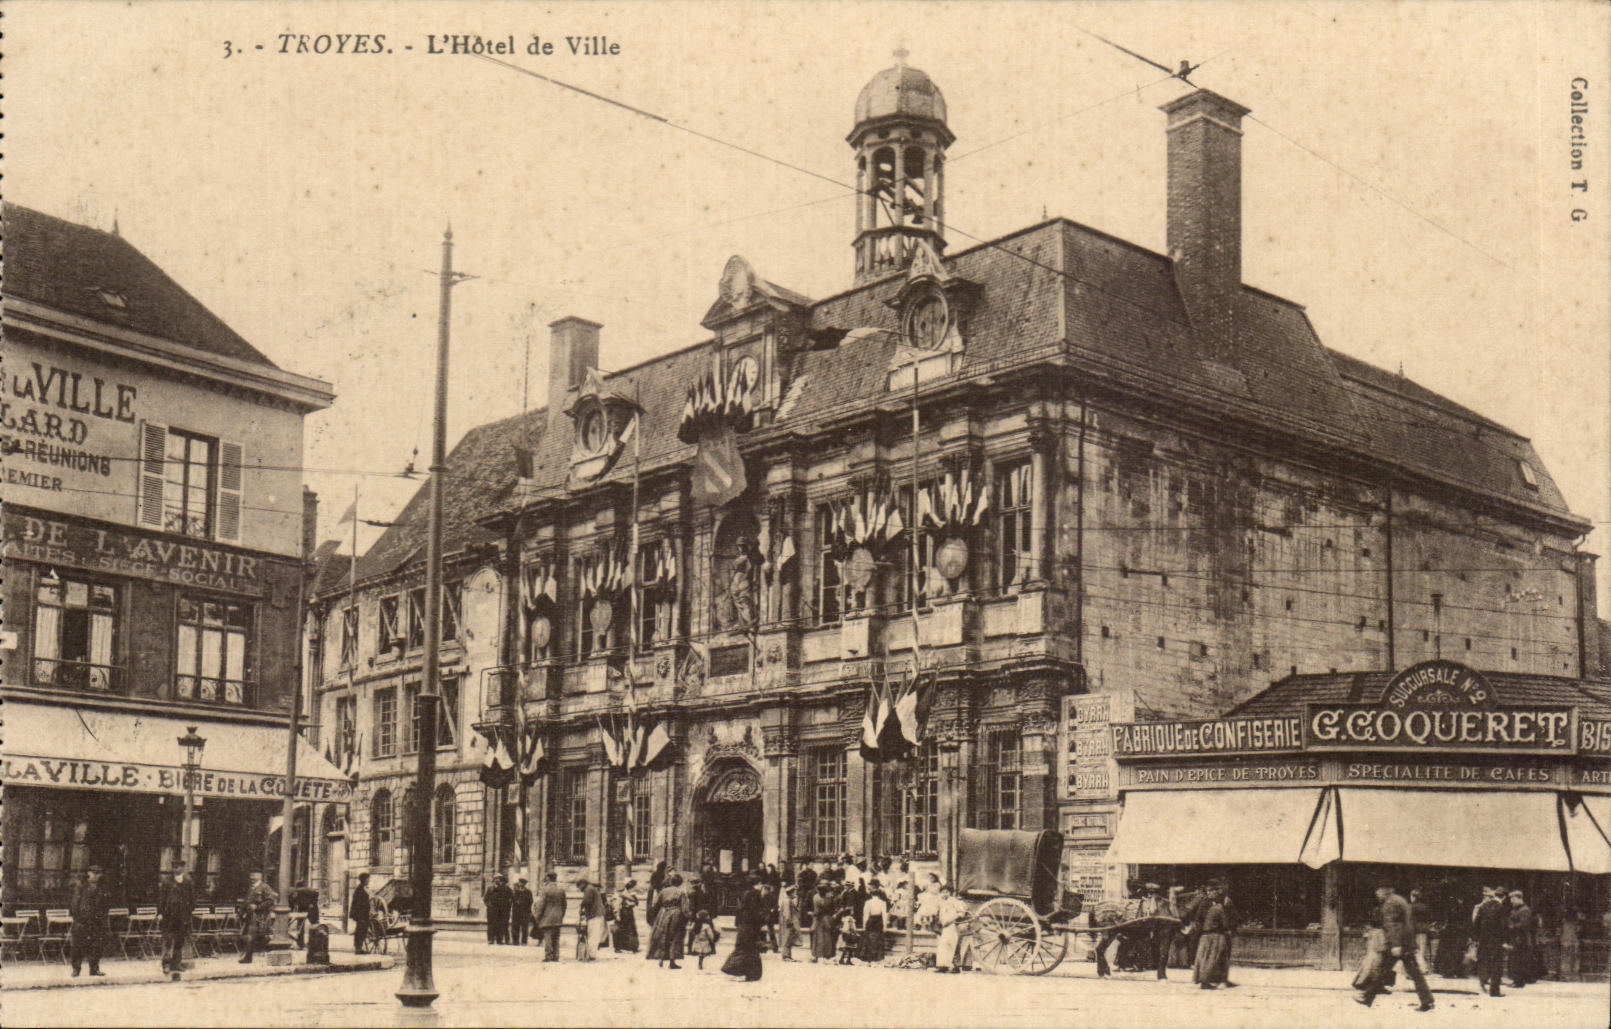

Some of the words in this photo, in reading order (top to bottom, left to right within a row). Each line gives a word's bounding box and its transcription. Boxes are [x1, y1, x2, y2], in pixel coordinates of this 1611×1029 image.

[13, 375, 35, 401] LA
[32, 362, 137, 424] VILLE
[2, 466, 62, 491] EMIER
[23, 516, 69, 547] DE
[169, 568, 239, 589] SOCIAL
[1389, 668, 1460, 708] SUCCURSALE
[1111, 723, 1183, 752] FABRIQUE
[1184, 729, 1199, 750] DE
[1199, 719, 1301, 750] CONFISERIE
[4, 761, 42, 781] LA
[40, 760, 139, 786] VILLE
[217, 777, 235, 793] DE
[239, 779, 258, 796] LA
[1139, 769, 1169, 783] PAIN
[1233, 767, 1250, 780] DE
[1255, 765, 1316, 780] TROYES
[1460, 765, 1480, 780] DE
